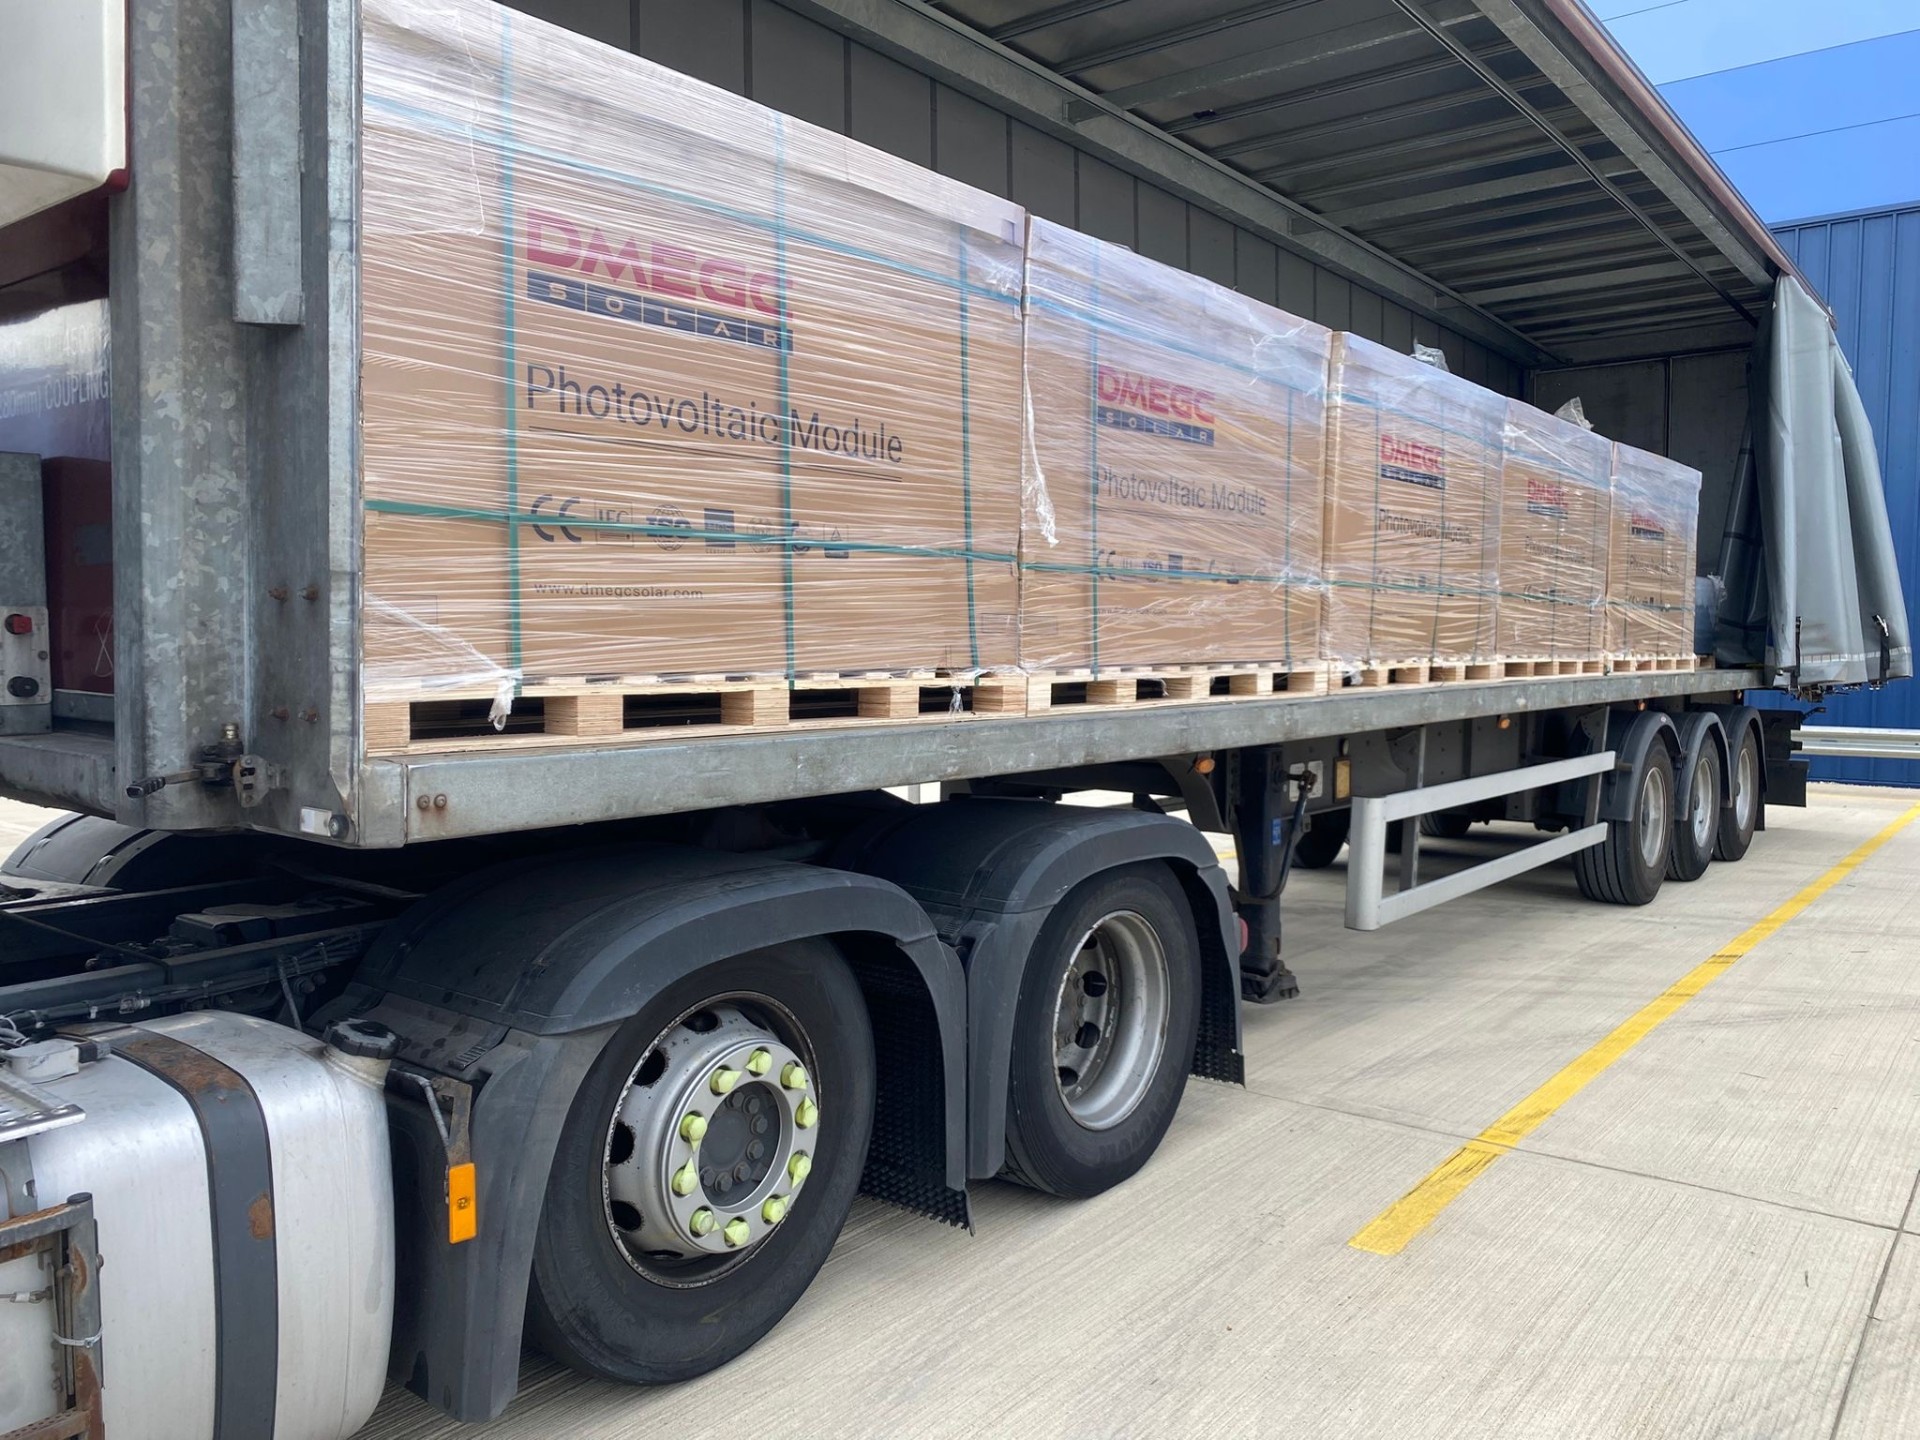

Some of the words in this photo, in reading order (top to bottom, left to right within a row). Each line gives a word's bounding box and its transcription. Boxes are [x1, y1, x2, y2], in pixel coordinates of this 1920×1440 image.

[527, 208, 793, 320] DMEGC
[548, 281, 783, 348] SOLAR
[45, 368, 109, 410] COUPLING
[526, 363, 780, 444] Photovoltaic
[791, 407, 903, 463] Module
[1098, 364, 1215, 424] DMEGC
[1105, 411, 1208, 442] SOLAR
[534, 582, 704, 600] www.dmegcsolar.com
